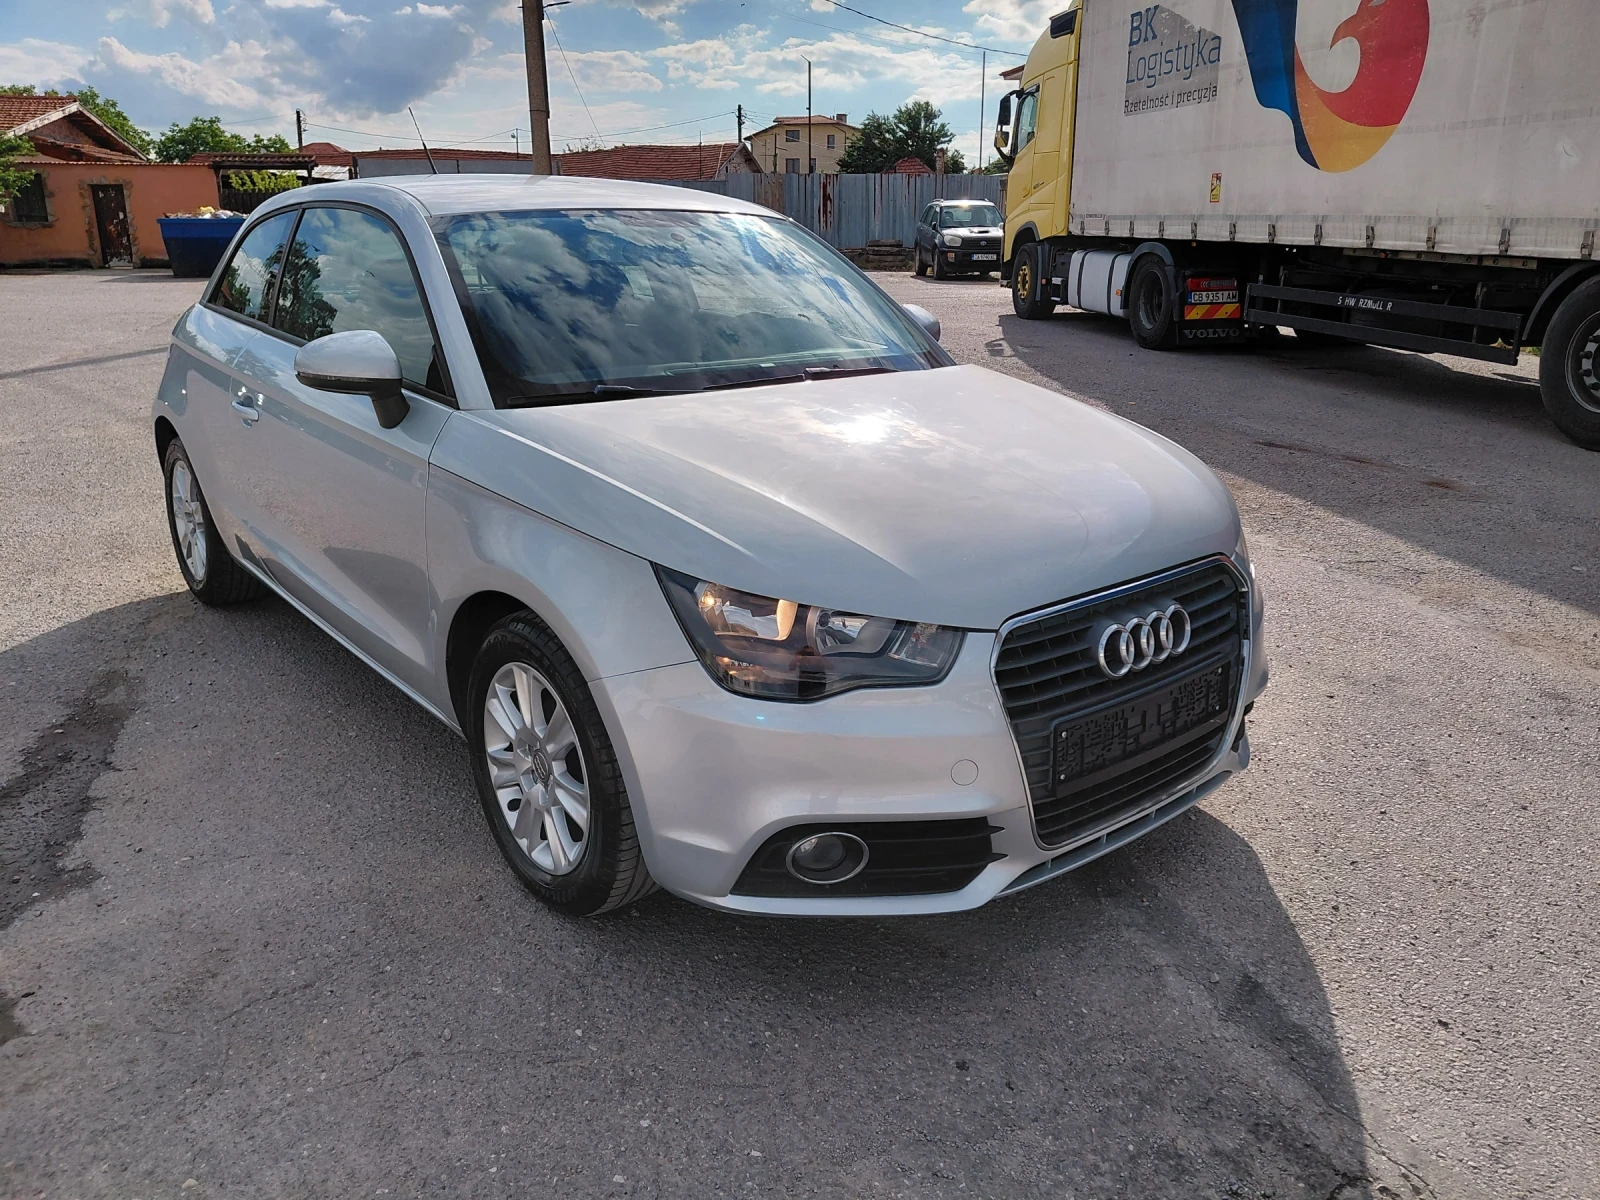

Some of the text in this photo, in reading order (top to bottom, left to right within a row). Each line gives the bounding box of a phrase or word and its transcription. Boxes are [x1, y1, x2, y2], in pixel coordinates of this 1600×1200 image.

[1129, 4, 1159, 47] BK
[1126, 29, 1222, 88] Logistyka
[1124, 93, 1169, 113] Rzetelność
[1176, 82, 1218, 108] precyzja
[1192, 292, 1204, 302] CB
[1226, 290, 1238, 301] AM
[1183, 328, 1240, 339] VOLVO
